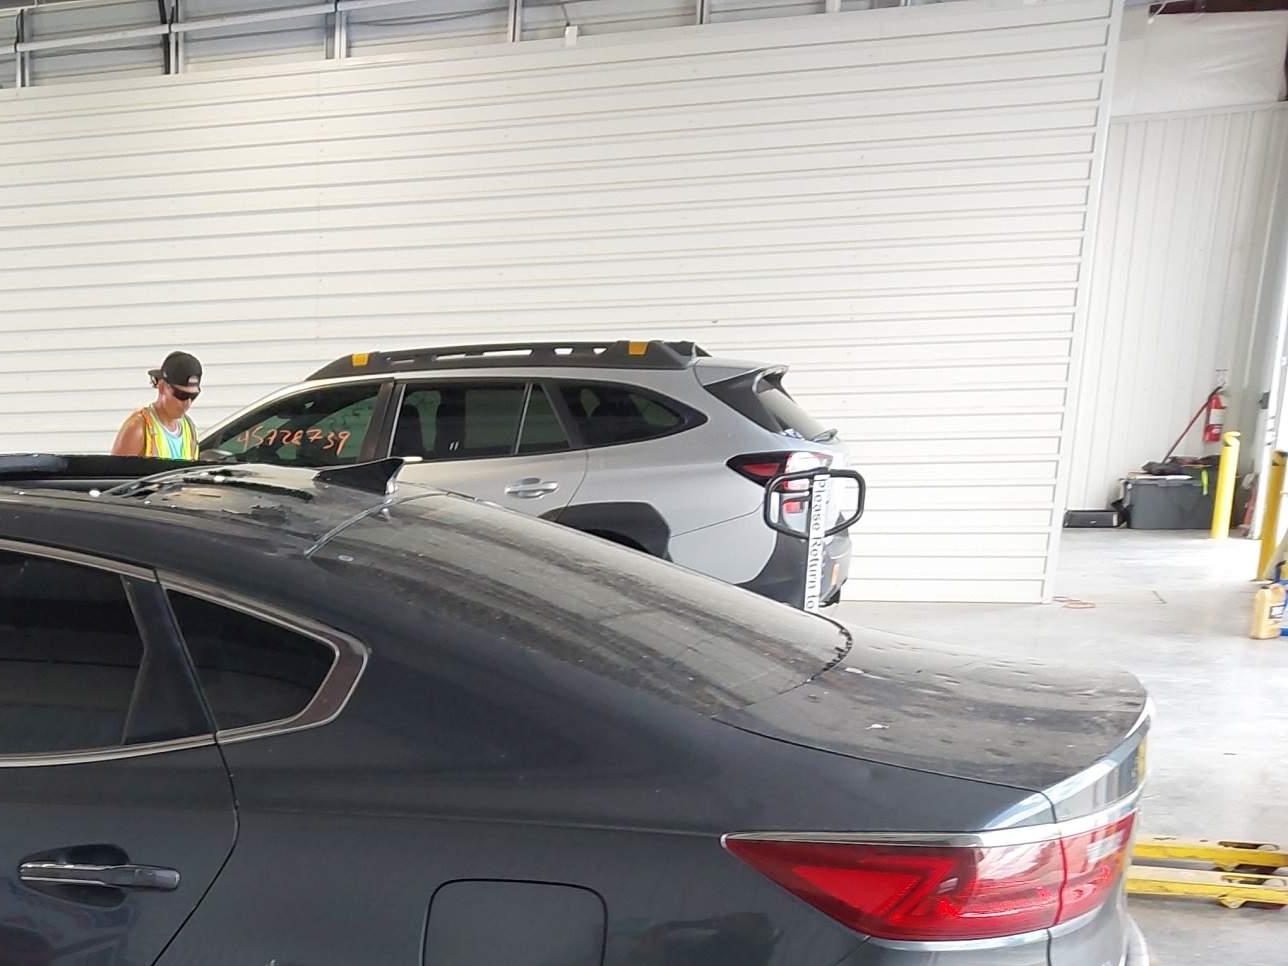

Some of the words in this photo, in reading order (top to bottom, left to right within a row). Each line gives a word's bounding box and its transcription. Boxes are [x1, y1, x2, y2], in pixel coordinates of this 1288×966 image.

[812, 479, 826, 531] Please
[806, 536, 823, 588] Return
[806, 594, 816, 610] to
